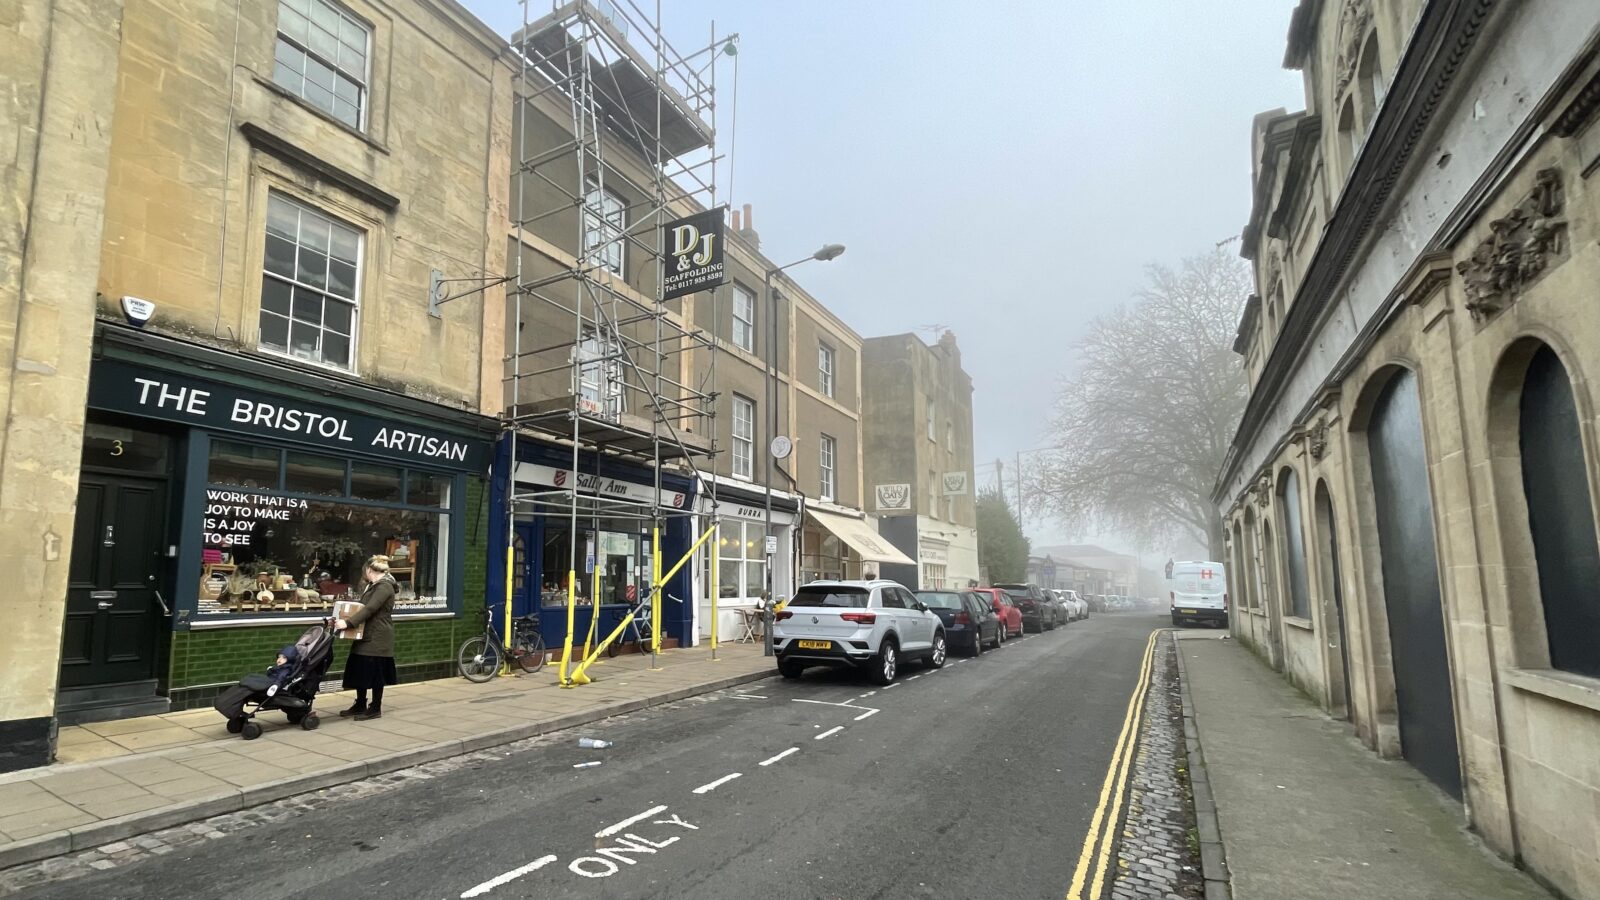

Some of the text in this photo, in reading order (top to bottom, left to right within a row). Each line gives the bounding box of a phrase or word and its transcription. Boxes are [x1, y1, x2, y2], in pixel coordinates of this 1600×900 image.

[665, 263, 723, 284] SCAFFOLDING
[678, 279, 693, 289] 0117
[135, 378, 468, 462] THE BRISTOL ARTISAN
[110, 439, 123, 456] 3
[605, 479, 627, 494] Ann
[883, 485, 902, 493] WILD
[206, 490, 308, 509] WORK THAT IS A
[204, 504, 290, 520] JOY TO MAKE
[738, 507, 761, 518] BURRA
[203, 518, 256, 531] IS A JOY
[203, 532, 250, 545] TO SEE
[568, 813, 699, 878] ONLY
